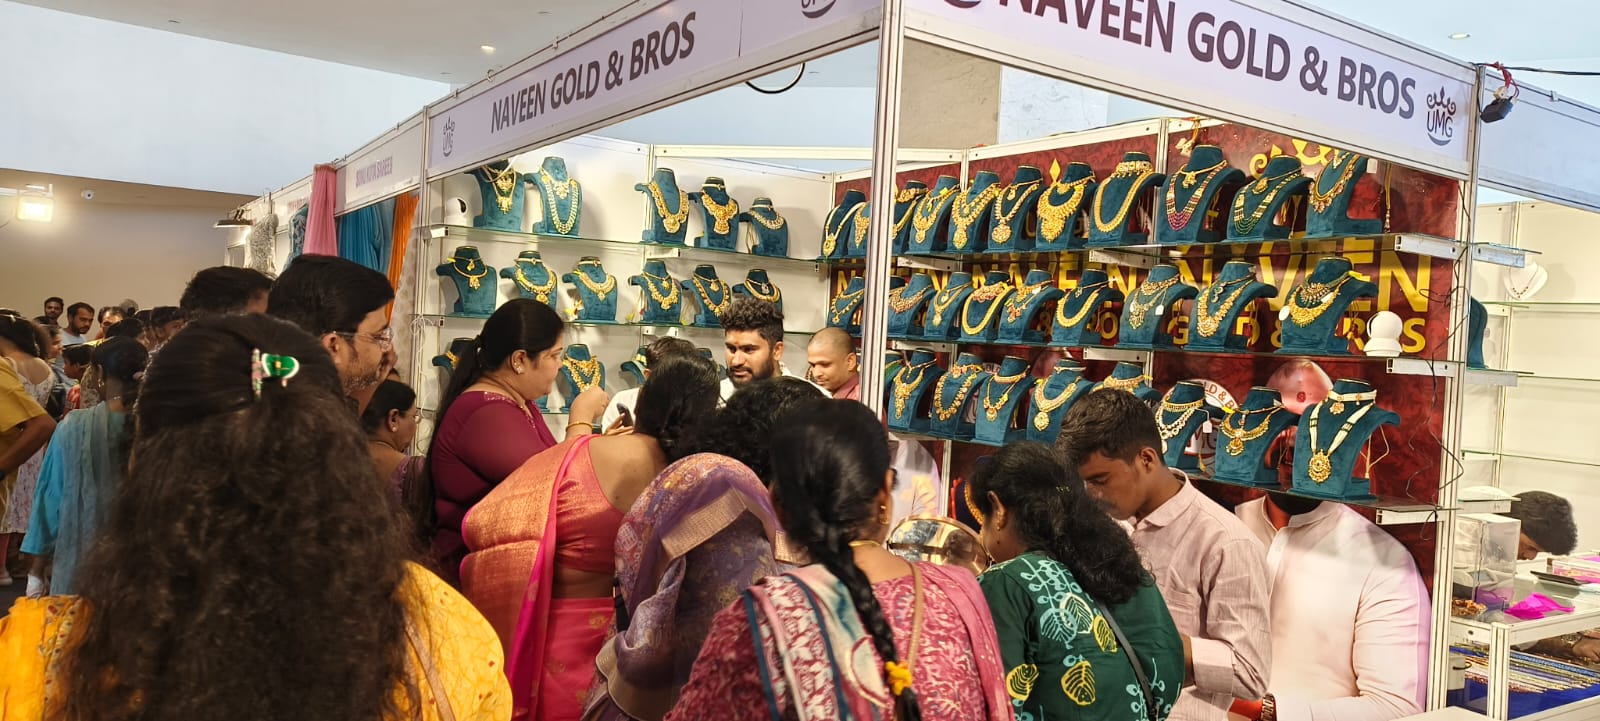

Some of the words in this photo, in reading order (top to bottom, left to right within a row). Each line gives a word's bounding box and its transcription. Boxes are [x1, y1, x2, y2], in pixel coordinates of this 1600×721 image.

[490, 87, 546, 134] NAVEEN
[550, 59, 600, 110] GOLD
[604, 50, 623, 87] &
[629, 11, 697, 81] BROS
[999, 0, 1176, 53] VEEN
[1187, 12, 1291, 82] GOLD
[1299, 46, 1328, 95] &
[1337, 57, 1416, 119] BROS
[1426, 109, 1453, 138] UMG
